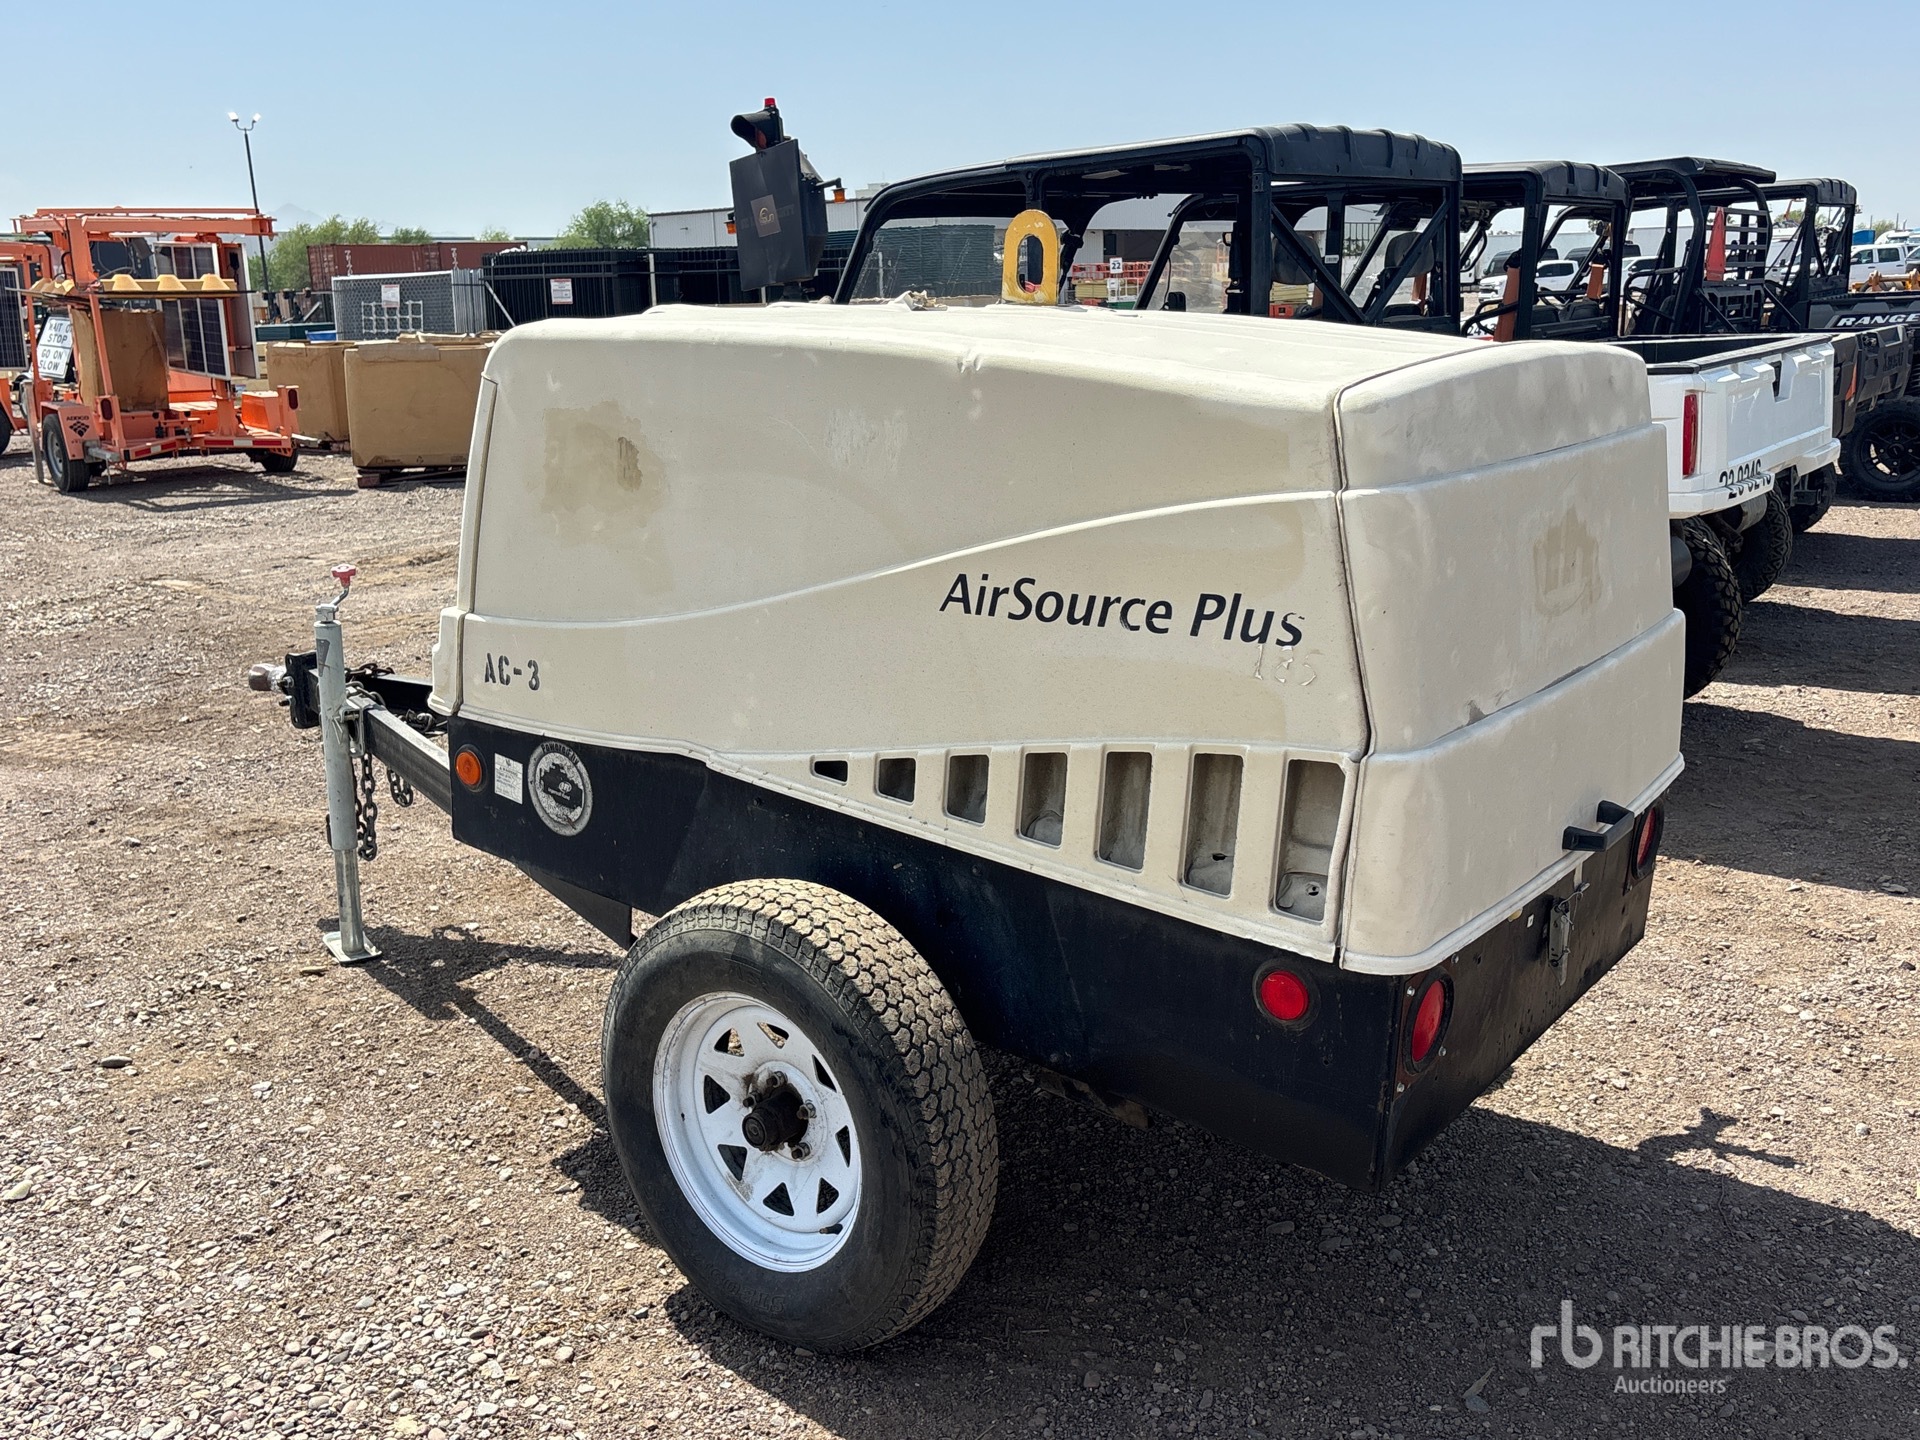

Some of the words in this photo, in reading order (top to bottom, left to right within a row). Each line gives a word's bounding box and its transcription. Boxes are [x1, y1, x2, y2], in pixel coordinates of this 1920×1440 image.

[47, 333, 67, 344] STOP
[41, 348, 50, 359] GO
[53, 350, 63, 361] ON
[39, 360, 60, 371] SLOW
[939, 573, 1173, 635] AirSource
[1190, 592, 1306, 648] Plus
[484, 652, 540, 691] AC-3
